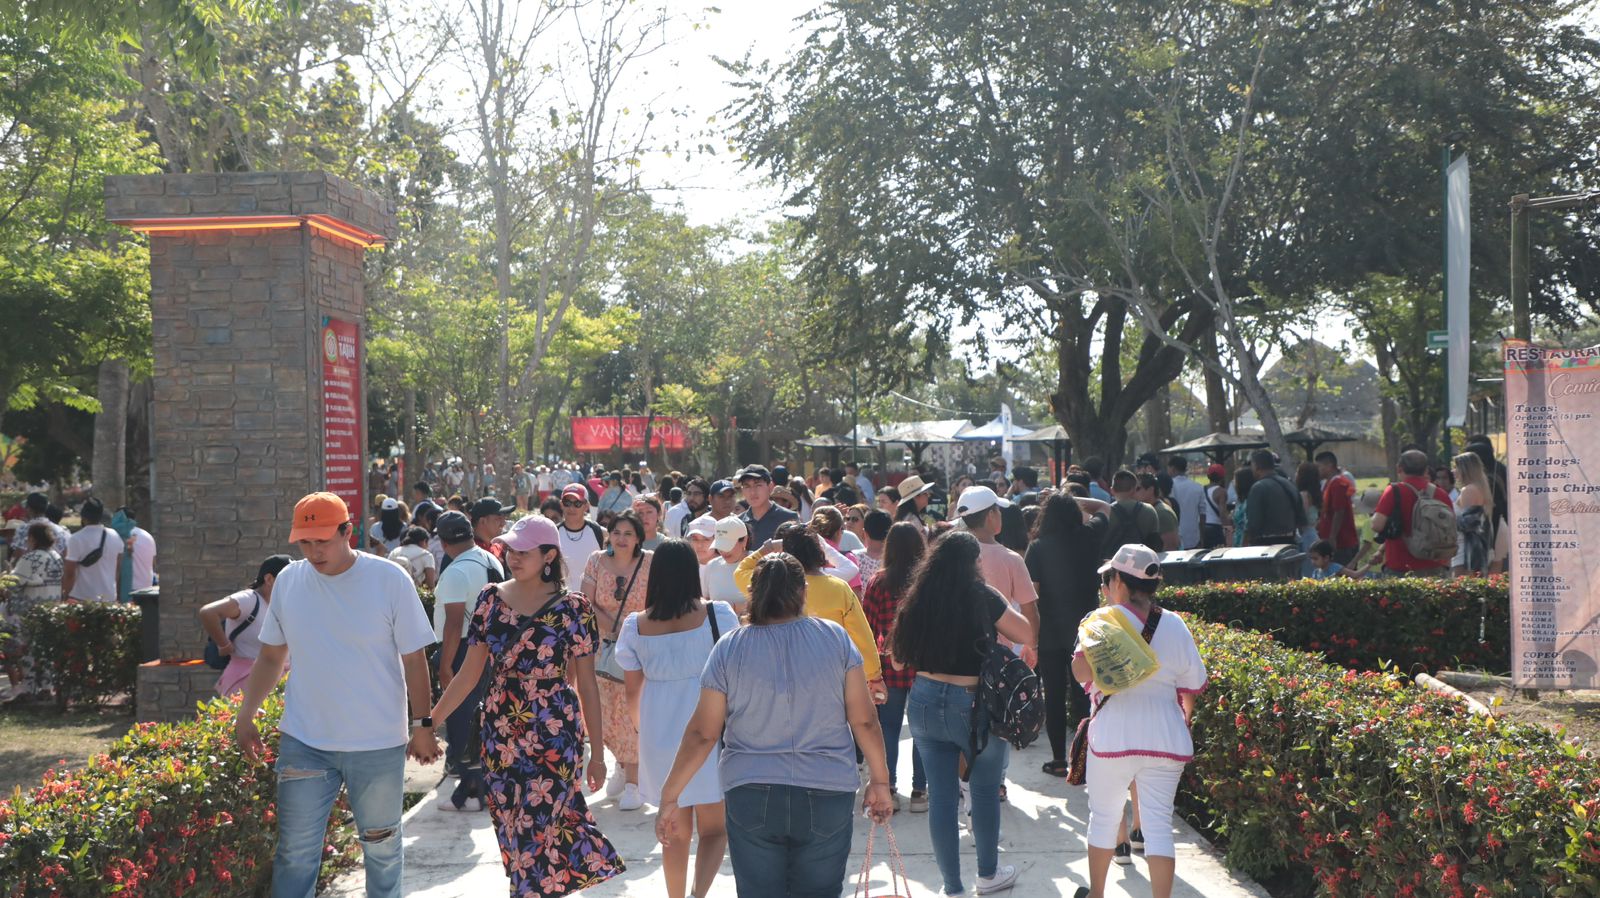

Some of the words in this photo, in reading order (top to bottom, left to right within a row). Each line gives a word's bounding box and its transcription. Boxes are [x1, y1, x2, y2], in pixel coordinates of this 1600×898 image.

[1506, 348, 1600, 360] RESTAURA
[1517, 457, 1580, 467] Hot-dogs:
[1517, 471, 1570, 479] Nachos:
[1518, 485, 1559, 495] Papas
[1518, 541, 1580, 549] CERVEZAS:
